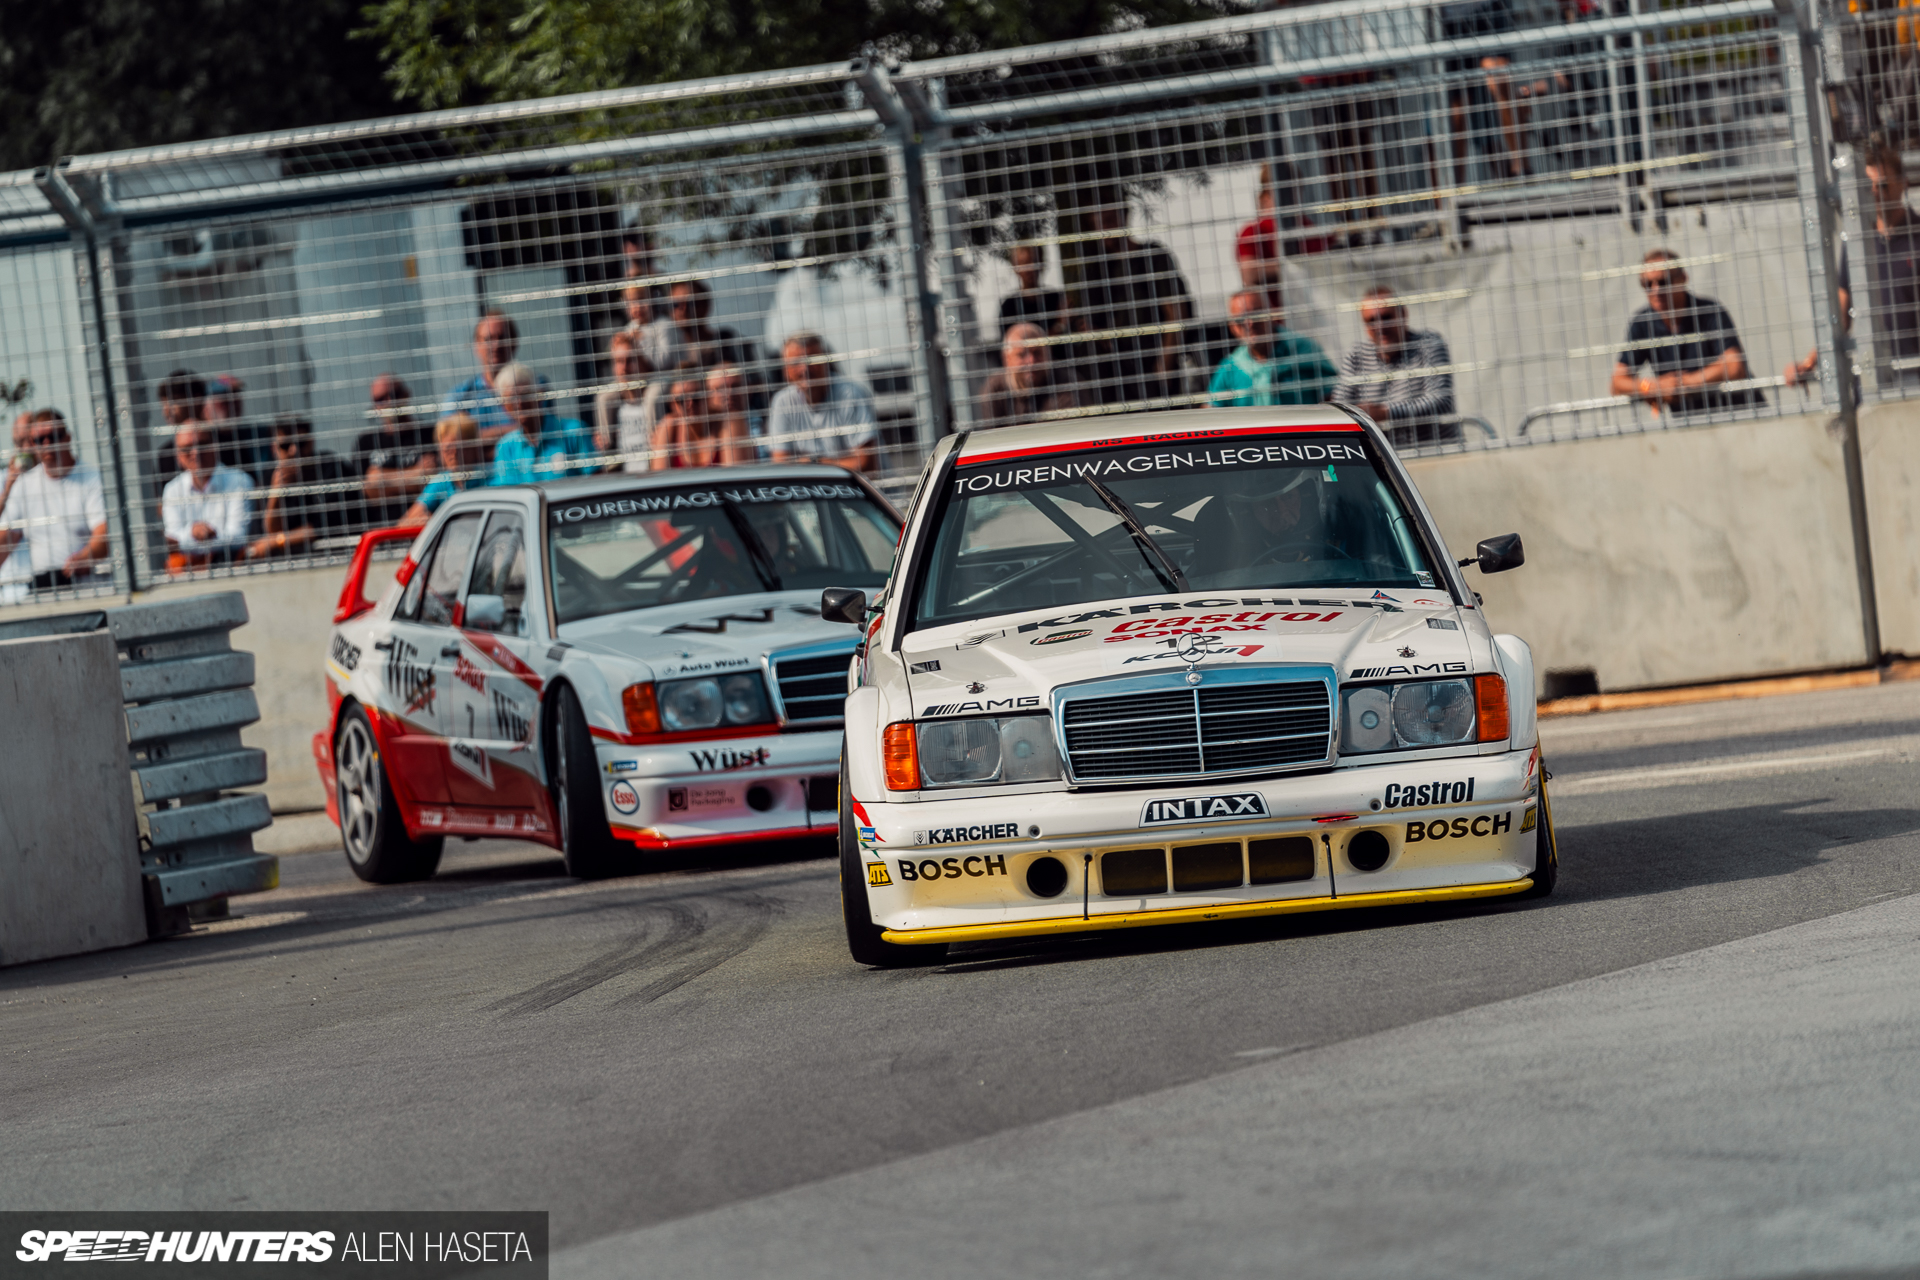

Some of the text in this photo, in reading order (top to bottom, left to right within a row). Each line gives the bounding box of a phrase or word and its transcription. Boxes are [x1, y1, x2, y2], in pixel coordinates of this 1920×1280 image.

[1092, 437, 1123, 447] MS
[1143, 429, 1225, 441] RACING
[954, 444, 1367, 494] TOURENWAGEN-LEGENDEN
[1111, 610, 1344, 634] Castrol
[1103, 624, 1268, 643] SONAX
[679, 662, 712, 673] Auto
[1385, 661, 1467, 677] AMG
[956, 695, 1040, 714] AMG
[688, 745, 770, 771] Wüst
[613, 788, 637, 806] Esso
[1384, 777, 1475, 809] Castrol
[1152, 795, 1259, 821] INTAX
[928, 823, 1019, 845] KÄRCHER
[1405, 811, 1512, 844] BOSCH
[868, 864, 889, 885] ATS
[898, 854, 1008, 882] BOSCH
